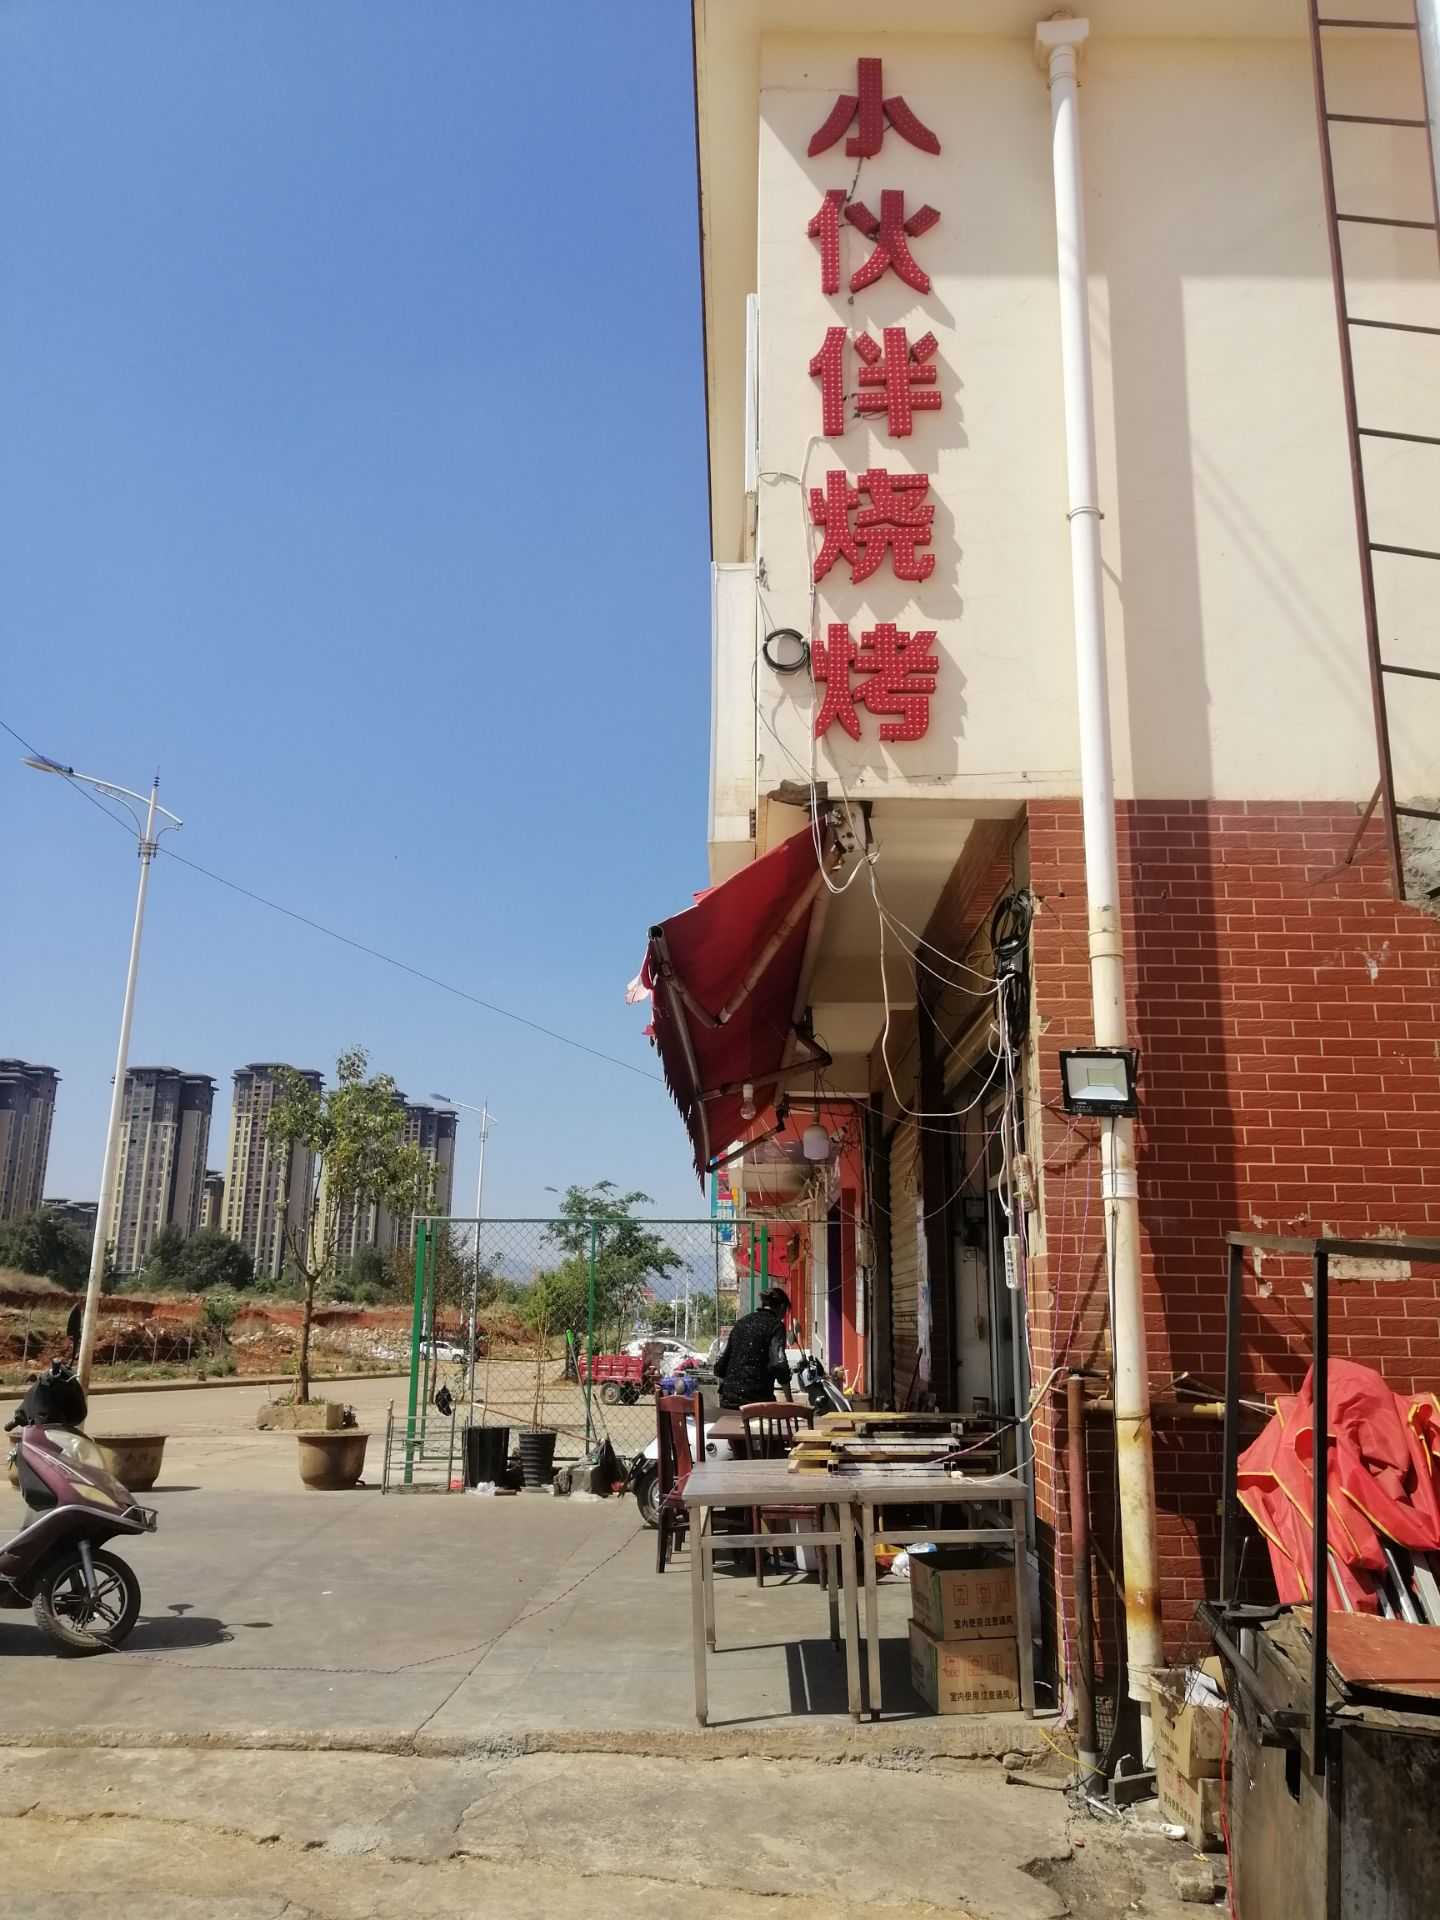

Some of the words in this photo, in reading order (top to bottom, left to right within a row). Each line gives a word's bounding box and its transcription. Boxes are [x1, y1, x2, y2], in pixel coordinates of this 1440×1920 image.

[808, 57, 941, 742] 小伙伴烧烤
